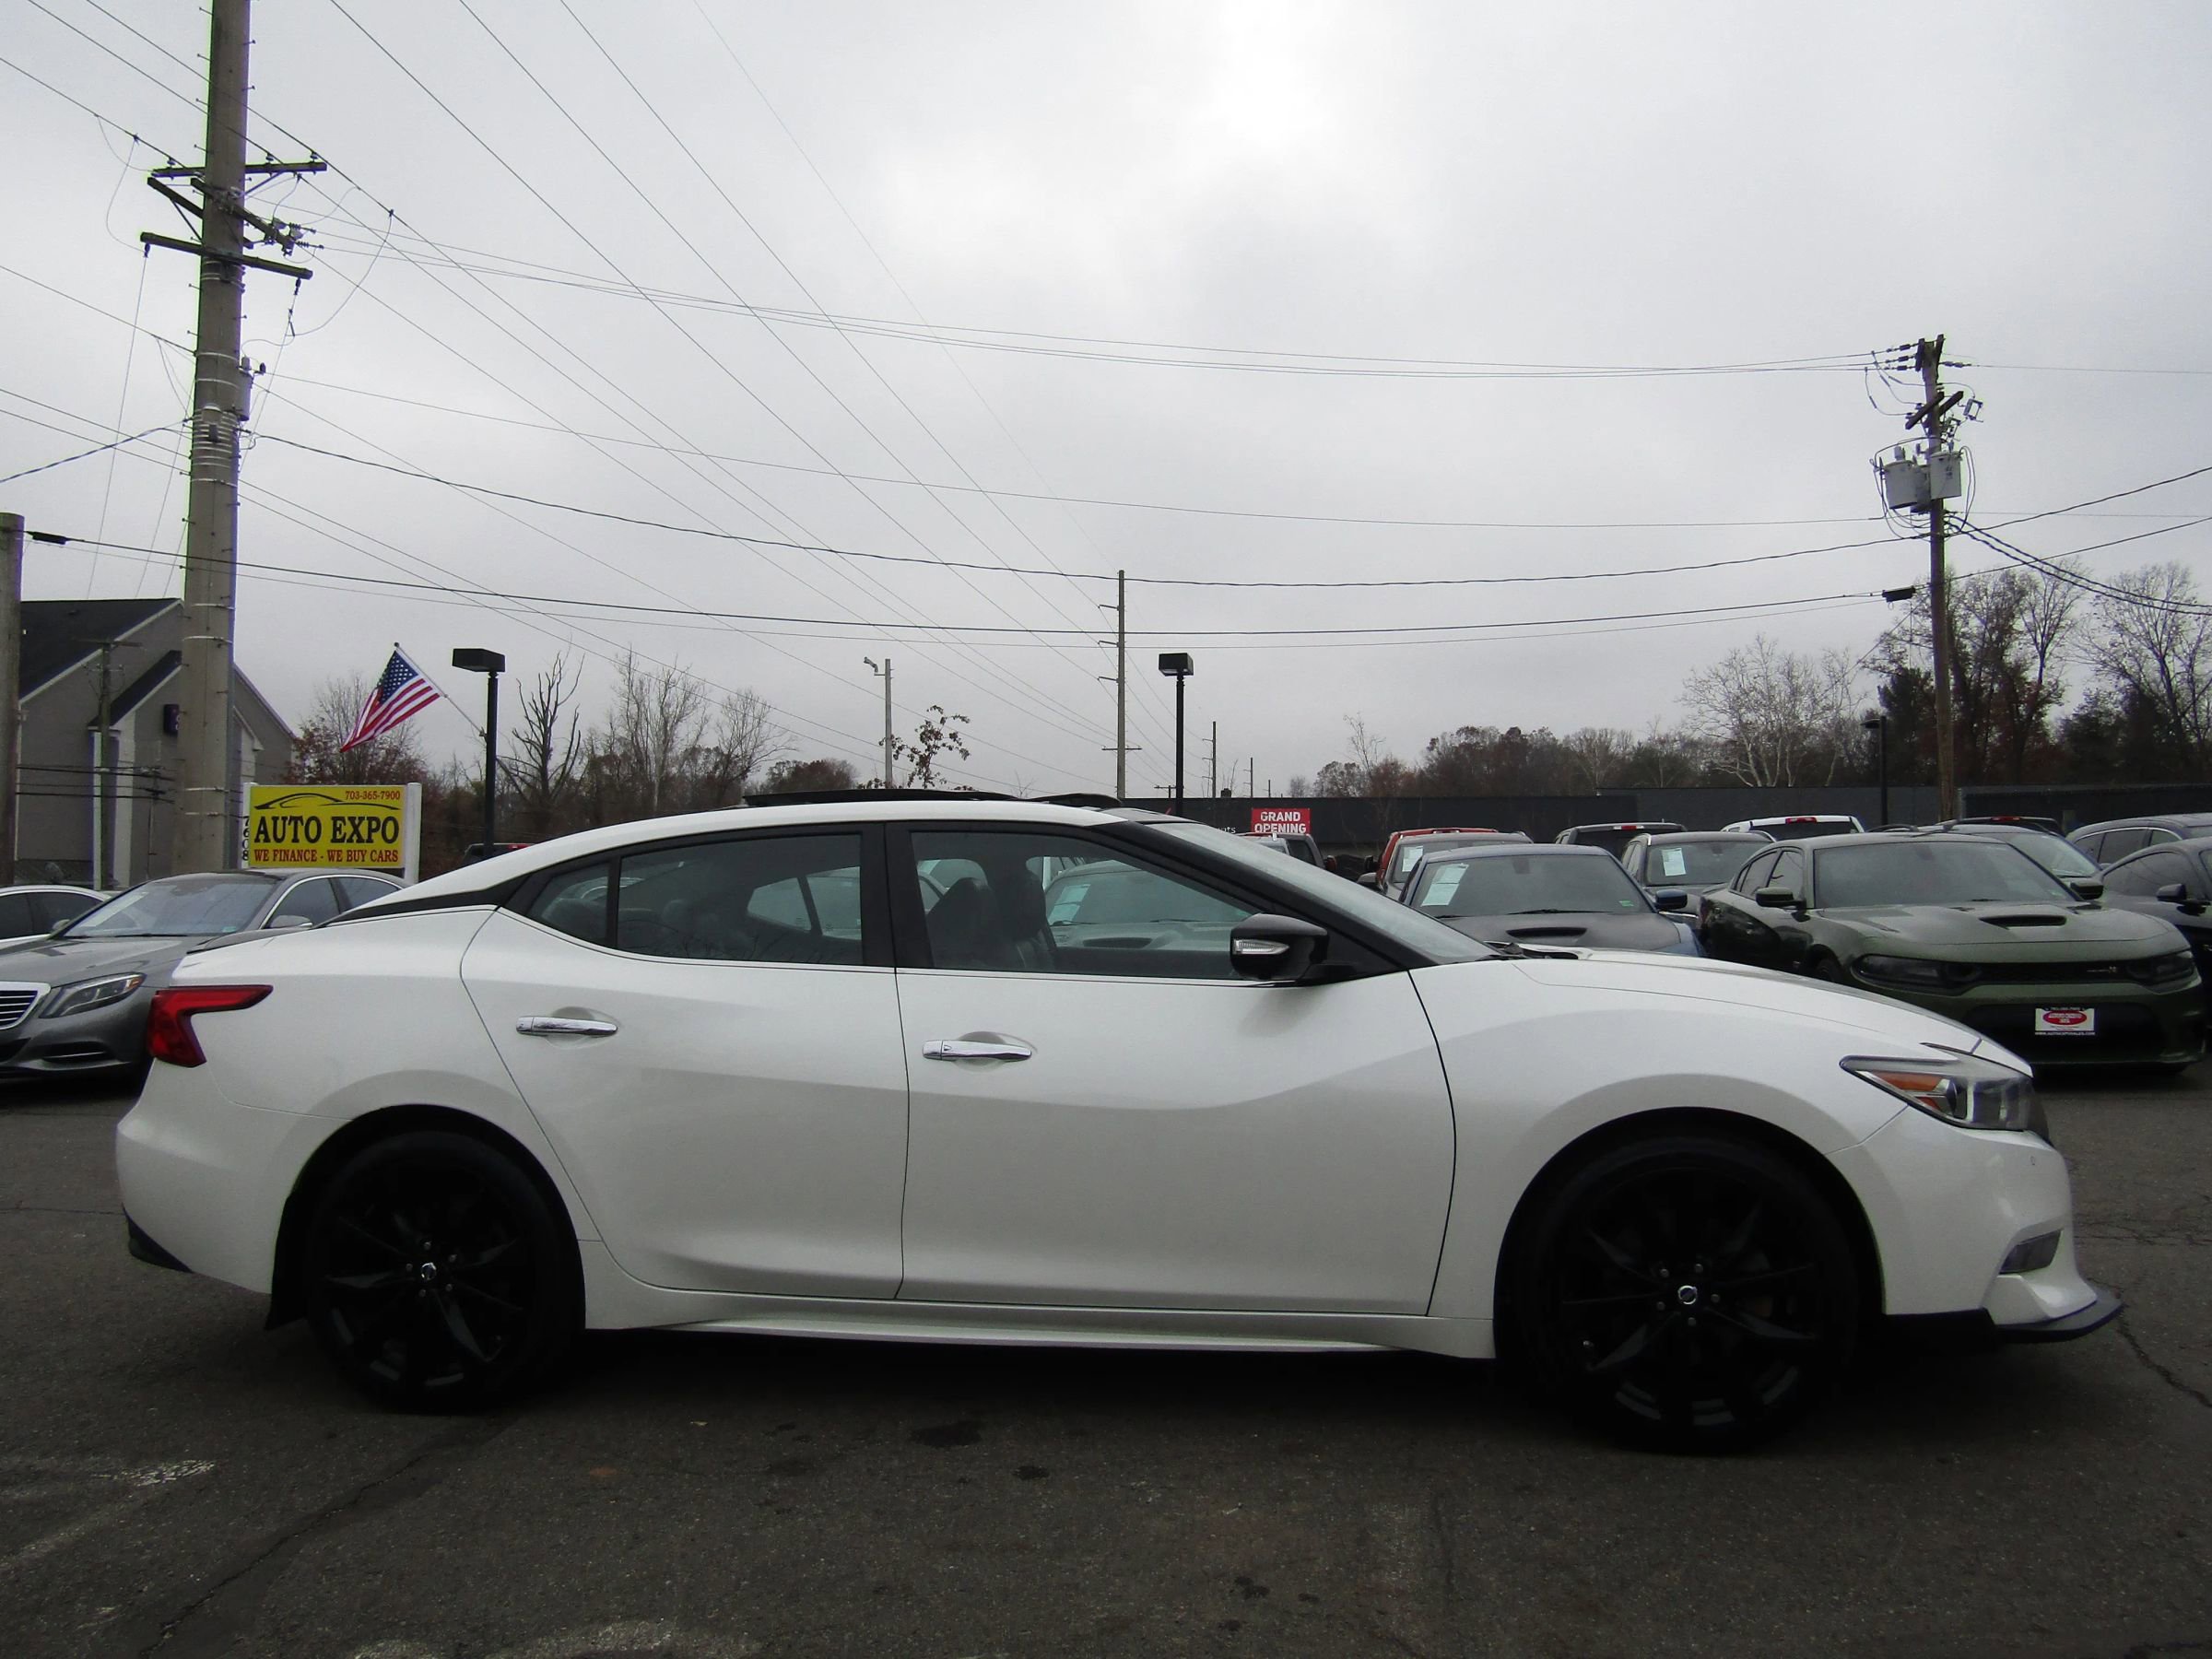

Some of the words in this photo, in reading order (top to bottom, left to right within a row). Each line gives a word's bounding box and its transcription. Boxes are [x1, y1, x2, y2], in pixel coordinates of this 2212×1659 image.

[346, 791, 400, 800] 703-365-7900
[1260, 811, 1301, 822] GRAND
[253, 816, 322, 843] AUTO
[330, 816, 399, 844] EXPO
[1254, 823, 1307, 833] OPENING
[253, 849, 269, 862] WE
[273, 849, 317, 862] FINANCE
[327, 849, 343, 862] WE
[346, 849, 367, 862] BUY
[370, 849, 398, 863] CARS
